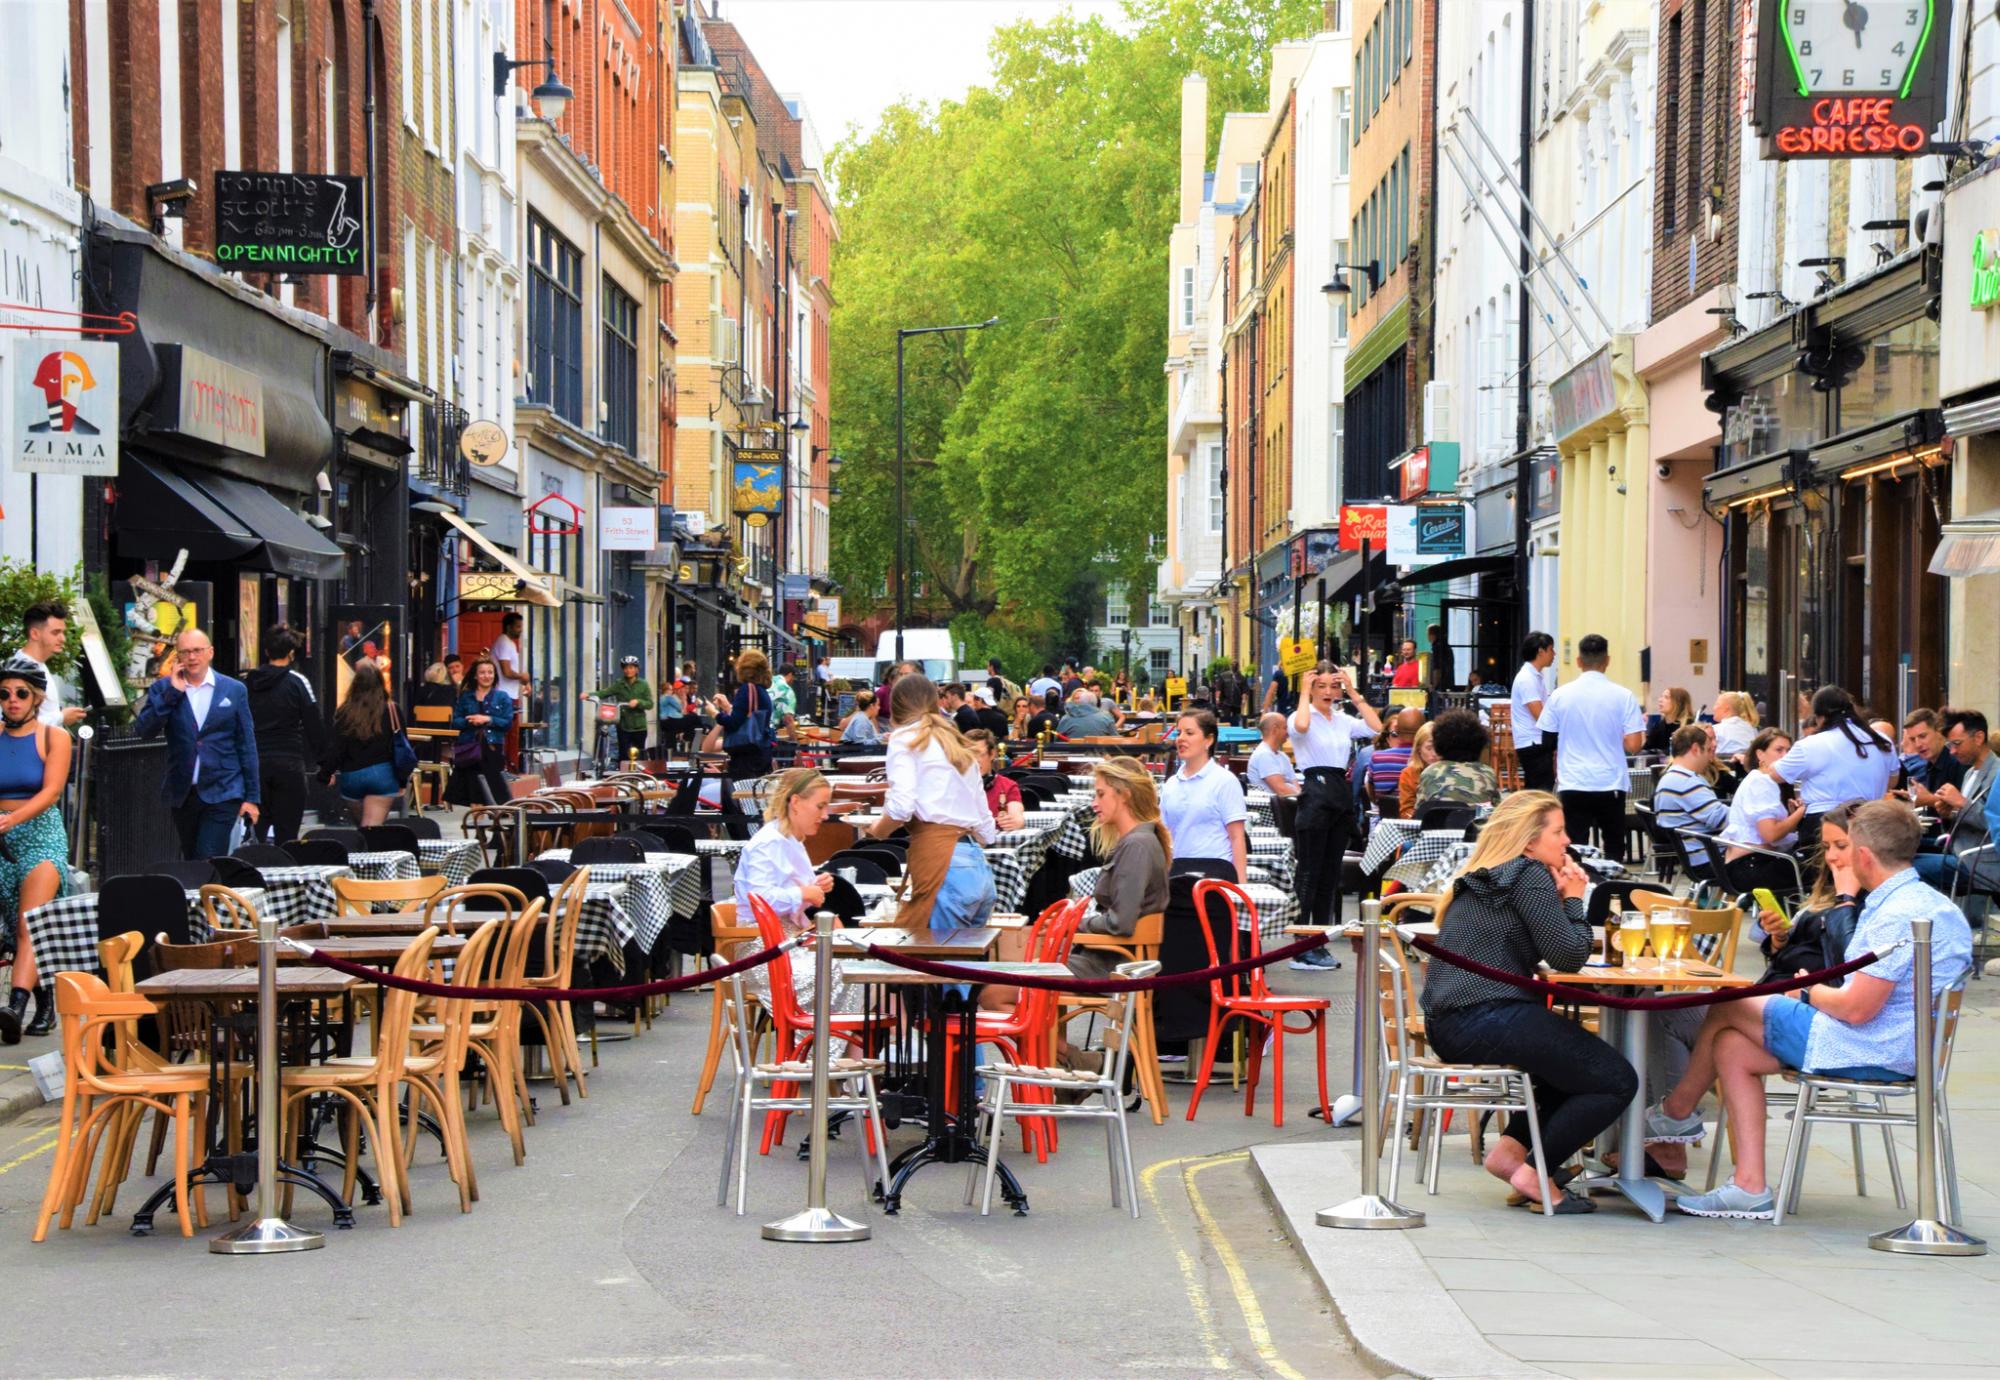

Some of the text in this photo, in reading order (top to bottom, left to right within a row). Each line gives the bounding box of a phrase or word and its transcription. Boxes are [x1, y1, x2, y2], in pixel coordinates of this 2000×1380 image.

[1793, 9, 1805, 26] 9
[1905, 9, 1918, 26] 3
[1800, 40, 1812, 56] 8
[1891, 41, 1905, 57] 4
[1810, 69, 1891, 86] 7 6 5
[1811, 98, 1893, 126] CAFFE
[23, 439, 105, 457] ZIMA
